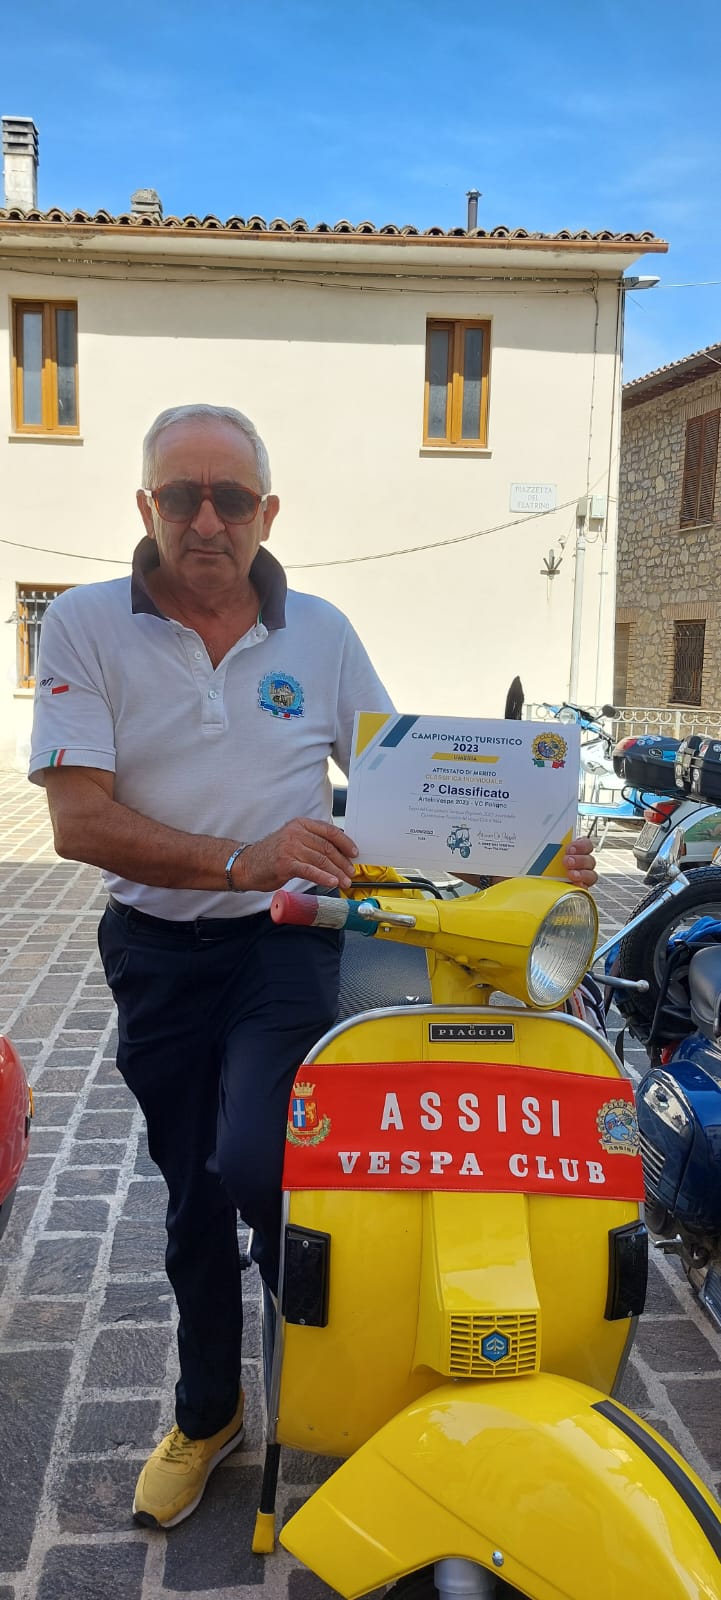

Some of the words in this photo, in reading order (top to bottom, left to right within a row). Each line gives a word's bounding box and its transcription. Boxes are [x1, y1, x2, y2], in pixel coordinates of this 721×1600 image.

[411, 732, 473, 743] CAMPIONATO
[475, 736, 523, 746] TURISTICO
[452, 743, 479, 753] 2023
[432, 767, 464, 775] ATTESTATO
[422, 783, 435, 793] 2°
[438, 784, 510, 799] Classificato
[380, 1091, 561, 1137] ASSISI
[338, 1151, 484, 1176] VESPA
[508, 1153, 607, 1184] CLUB
